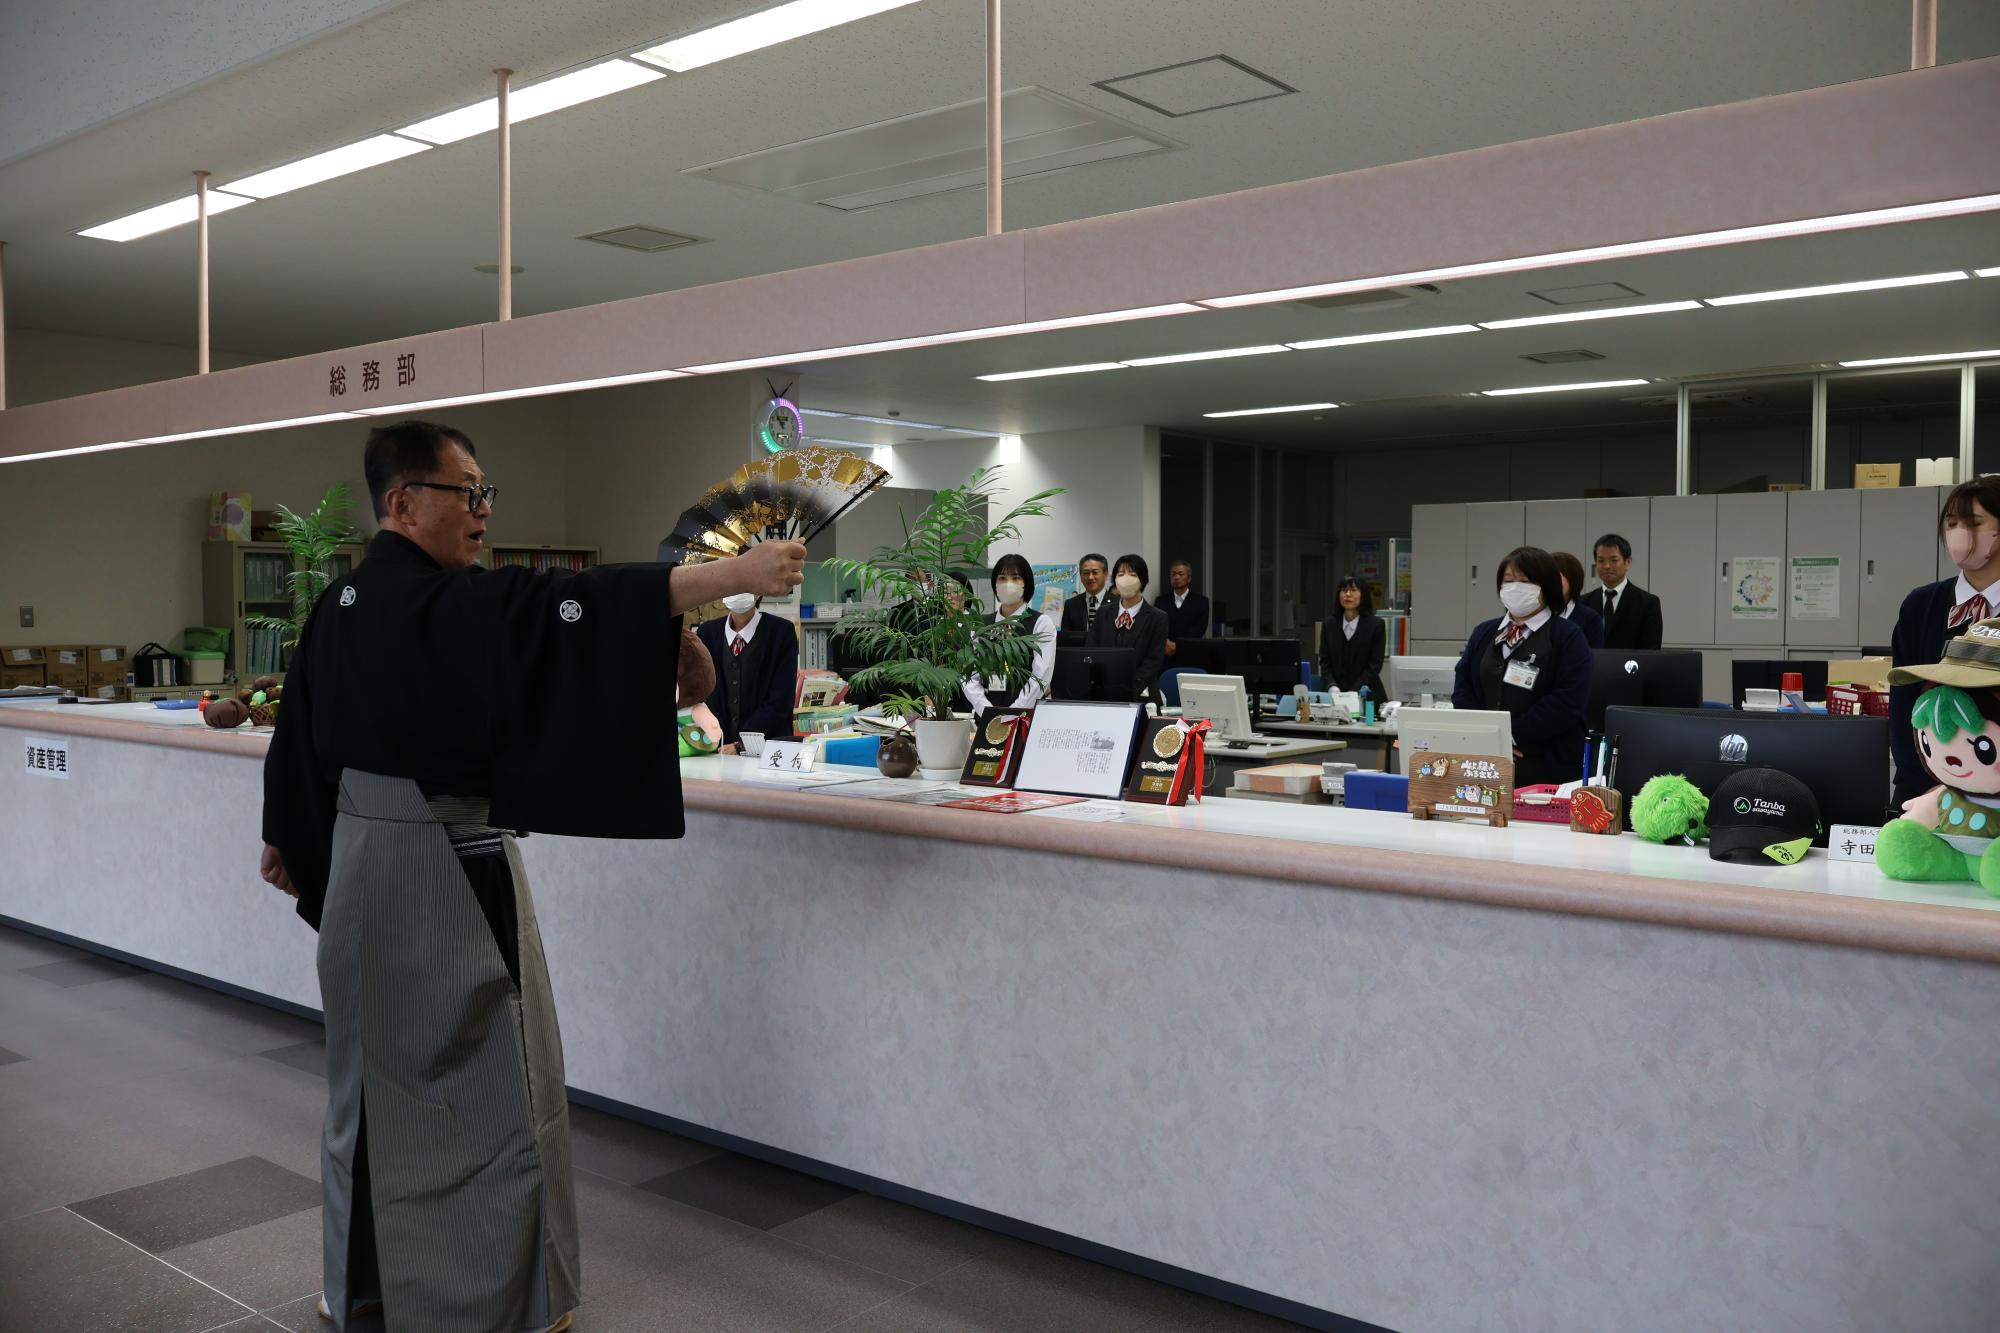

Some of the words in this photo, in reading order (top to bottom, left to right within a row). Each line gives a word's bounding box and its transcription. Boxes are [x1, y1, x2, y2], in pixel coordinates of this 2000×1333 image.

[329, 353, 416, 397] 総務部
[26, 745, 67, 772] 資産管理
[768, 749, 806, 770] 受付
[1720, 734, 1748, 761] hp
[1754, 798, 1786, 811] Tanba
[1840, 839, 1875, 856] 寺田
